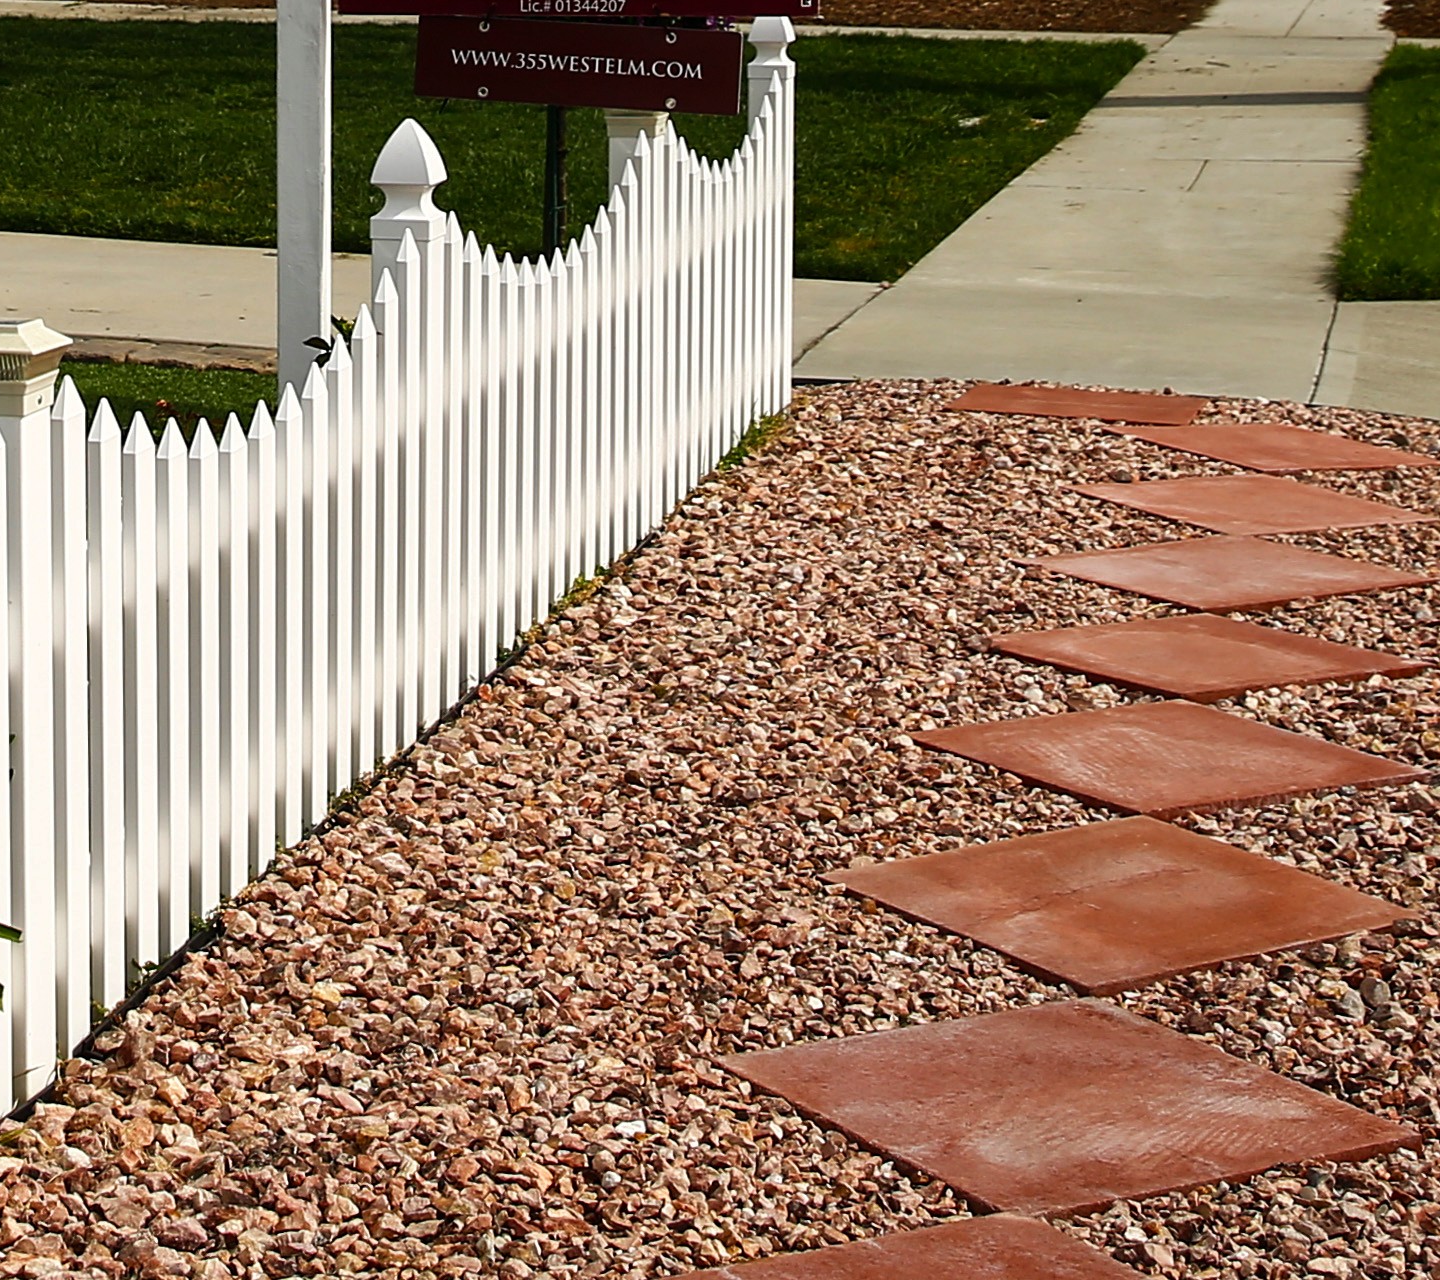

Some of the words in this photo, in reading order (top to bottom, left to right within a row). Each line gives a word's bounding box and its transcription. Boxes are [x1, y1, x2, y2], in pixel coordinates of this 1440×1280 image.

[519, 0, 551, 14] Lic.#
[554, 0, 626, 13] 01344207
[451, 48, 703, 80] WWW.355WESTELM.COM
